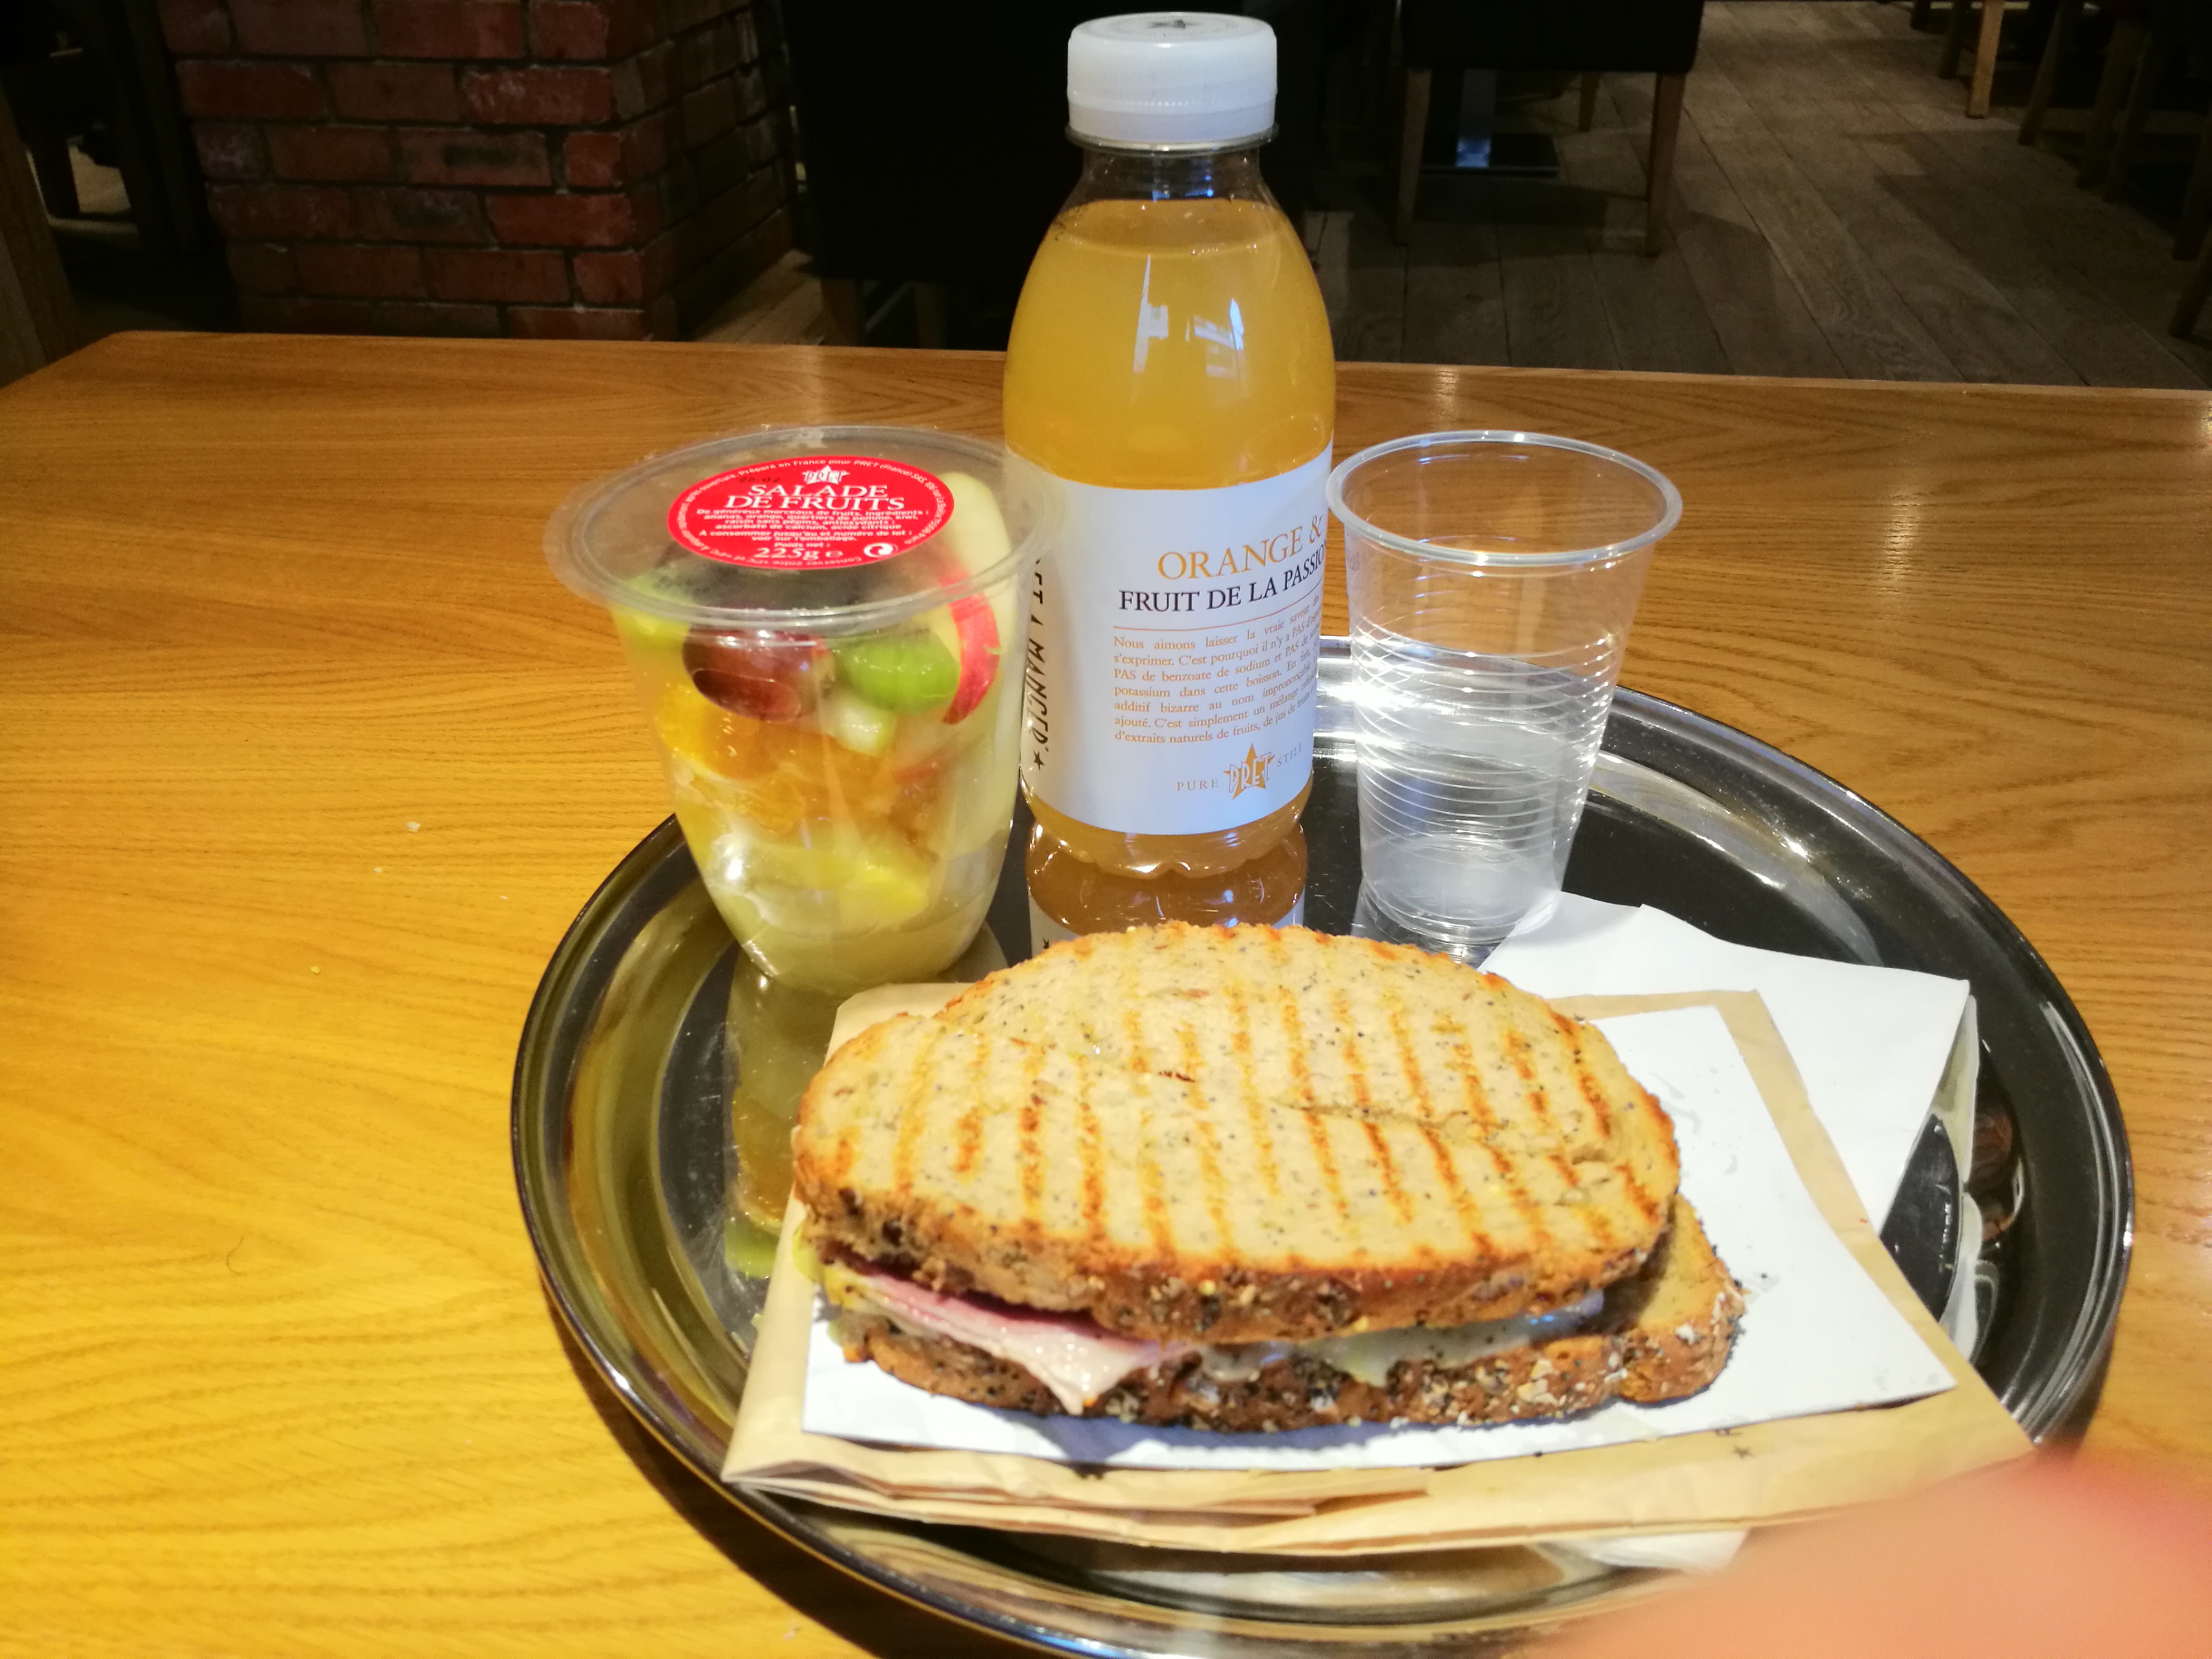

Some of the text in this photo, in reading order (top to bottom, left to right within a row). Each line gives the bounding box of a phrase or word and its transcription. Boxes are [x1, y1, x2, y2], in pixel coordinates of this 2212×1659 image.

[725, 495, 905, 511] DE FRUITS
[748, 484, 888, 497] SALADE
[754, 547, 819, 560] 225g
[1157, 515, 1323, 580] ORANGE &
[1118, 590, 1200, 613] FRUIT
[1206, 586, 1242, 610] DE
[1249, 576, 1278, 602] LA
[1113, 636, 1144, 649] Nous
[1154, 639, 1195, 649] aimons
[1205, 636, 1238, 647] laisser
[1246, 629, 1255, 640] la
[1264, 620, 1284, 635] vraie
[1114, 653, 1174, 667] s'exprimer.
[1178, 655, 1207, 666] C'est
[1210, 643, 1258, 666] pourquoi
[1262, 641, 1268, 652] il
[1271, 637, 1283, 648] n'y
[1292, 621, 1305, 638] PAS
[1114, 668, 1136, 680] PAS
[1142, 671, 1155, 681] de
[1161, 671, 1211, 681] benzoate
[1217, 667, 1230, 678] de
[1235, 659, 1270, 675] sodium
[1274, 653, 1282, 662] et
[1285, 641, 1299, 657] PAS
[1114, 686, 1171, 697] potassium
[1179, 686, 1206, 697] dans
[1214, 683, 1238, 693] cette
[1246, 670, 1282, 687] boisson.
[1287, 660, 1296, 672] En
[1114, 701, 1151, 712] additif
[1161, 702, 1200, 712] bizarre
[1209, 702, 1222, 710] au
[1231, 695, 1254, 706] nom
[1114, 716, 1151, 727] ajouté.
[1154, 717, 1182, 728] C'est
[1188, 711, 1248, 728] simplement
[1254, 706, 1265, 715] un
[1270, 688, 1298, 710] mélange
[1115, 730, 1166, 744] d'extraits
[1170, 731, 1213, 744] naturels
[1216, 728, 1229, 739] de
[1233, 723, 1260, 736] fruits,
[1263, 716, 1273, 727] de
[1275, 712, 1286, 724] jus
[1176, 741, 1303, 794] PURE PRET STILL
